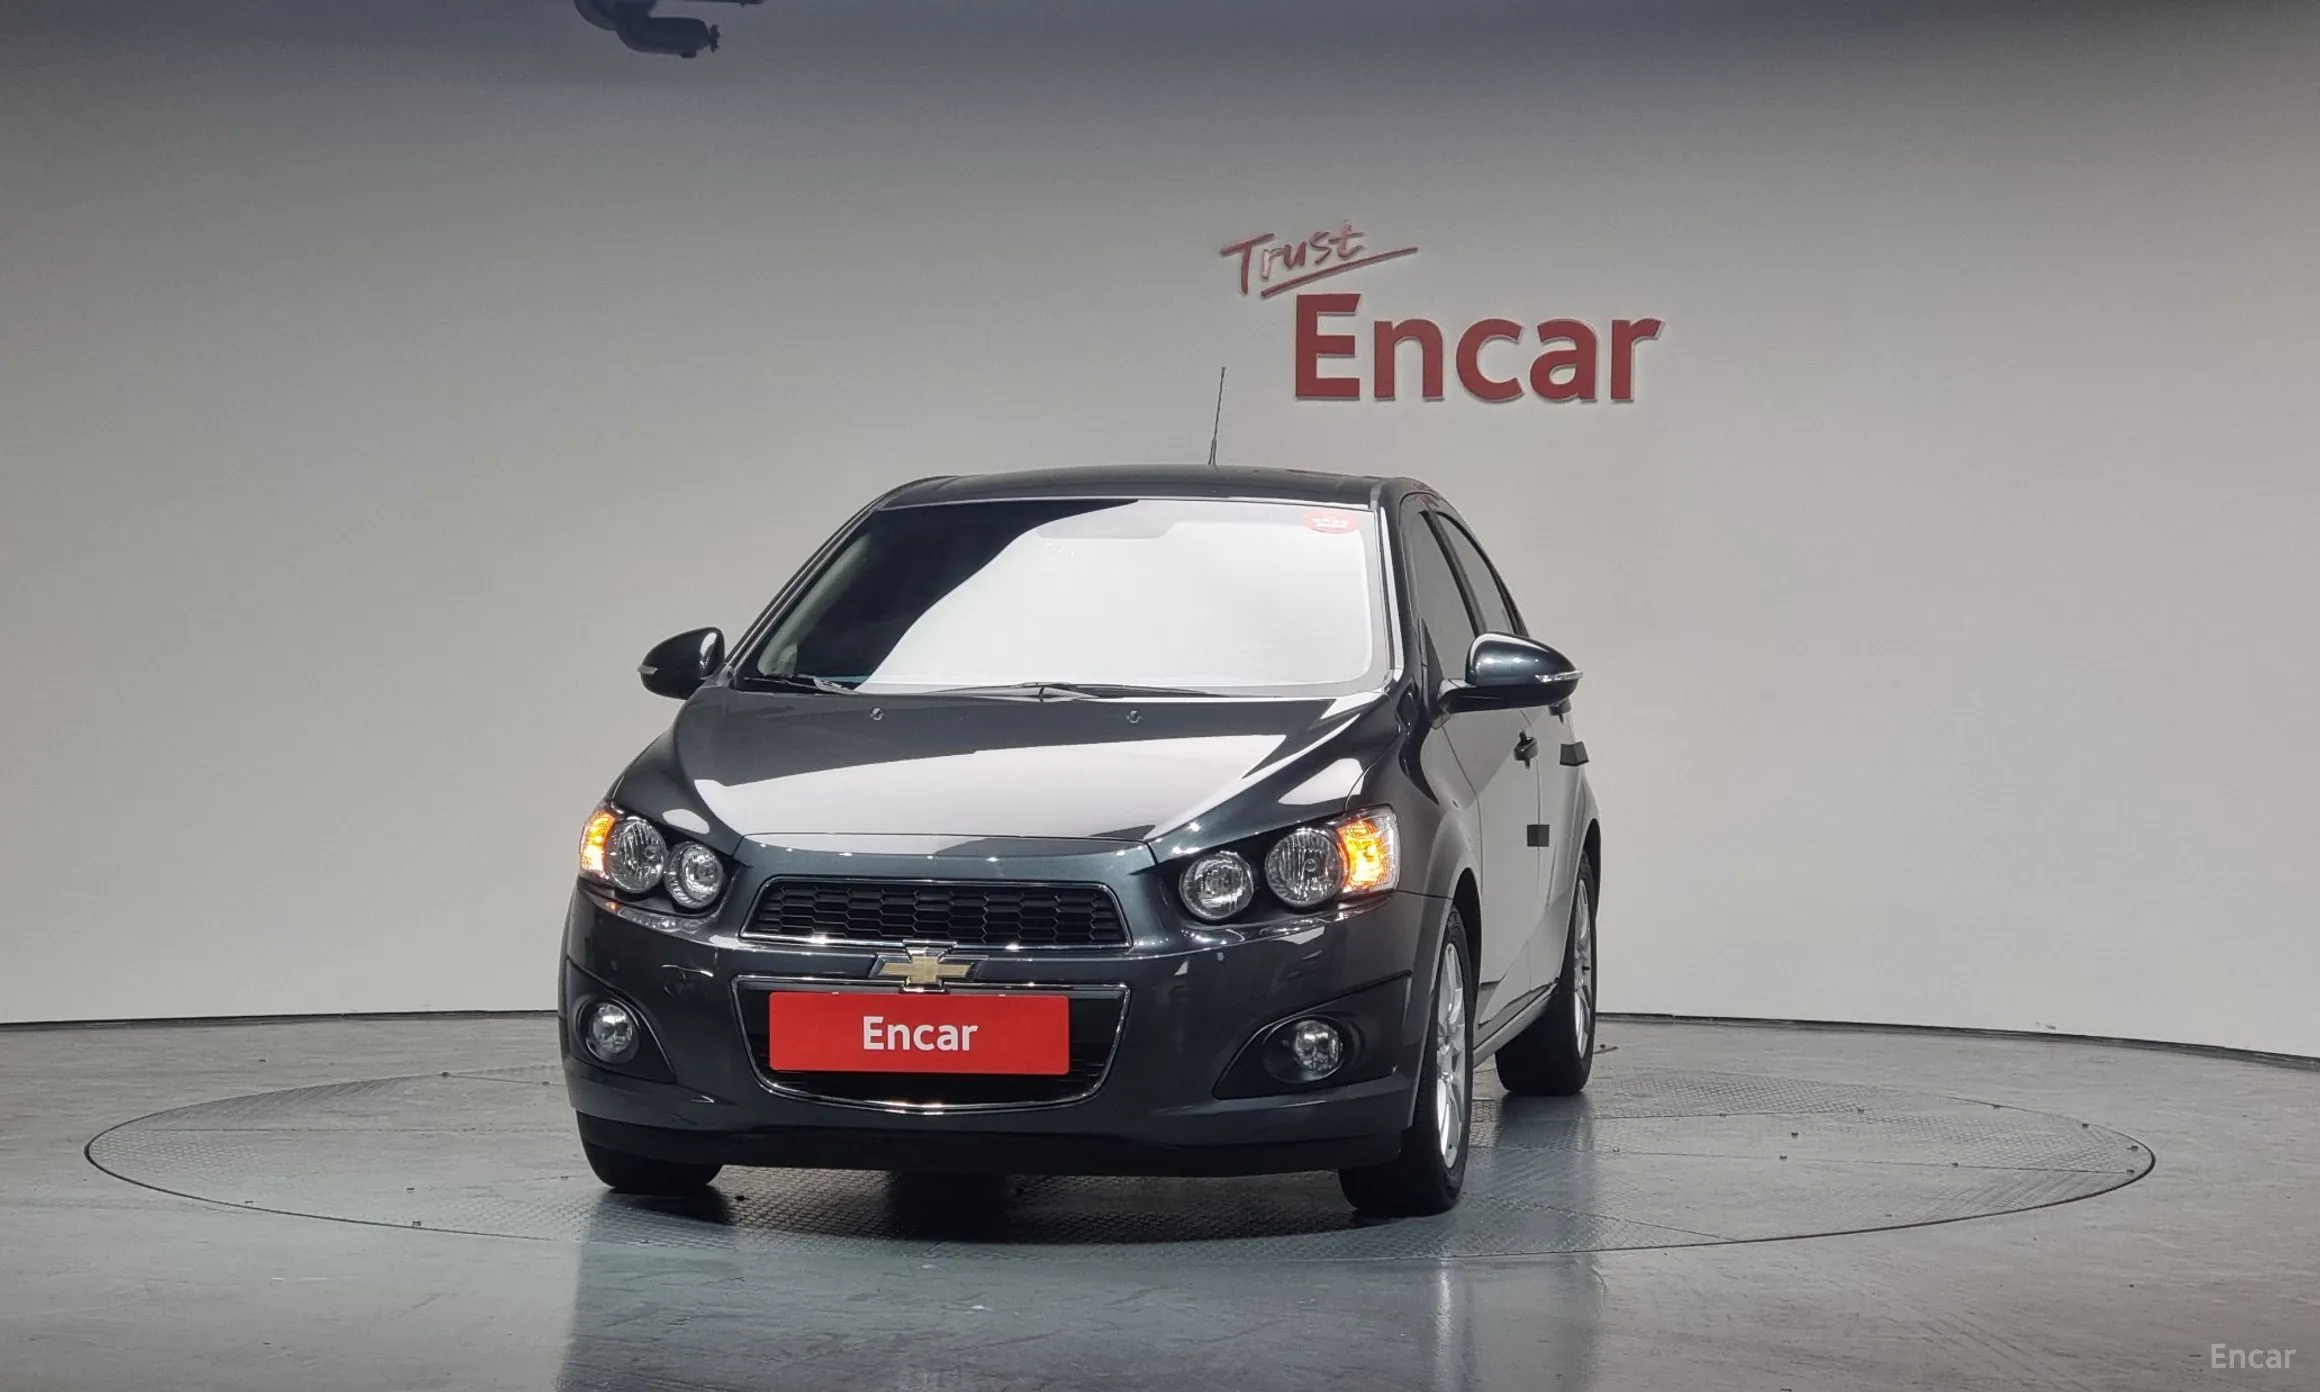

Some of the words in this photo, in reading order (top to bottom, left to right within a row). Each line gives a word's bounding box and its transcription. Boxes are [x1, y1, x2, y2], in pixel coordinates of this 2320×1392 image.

[1220, 220, 1367, 295] Trust
[1295, 293, 1665, 402] Encar
[862, 1015, 978, 1052] Encar
